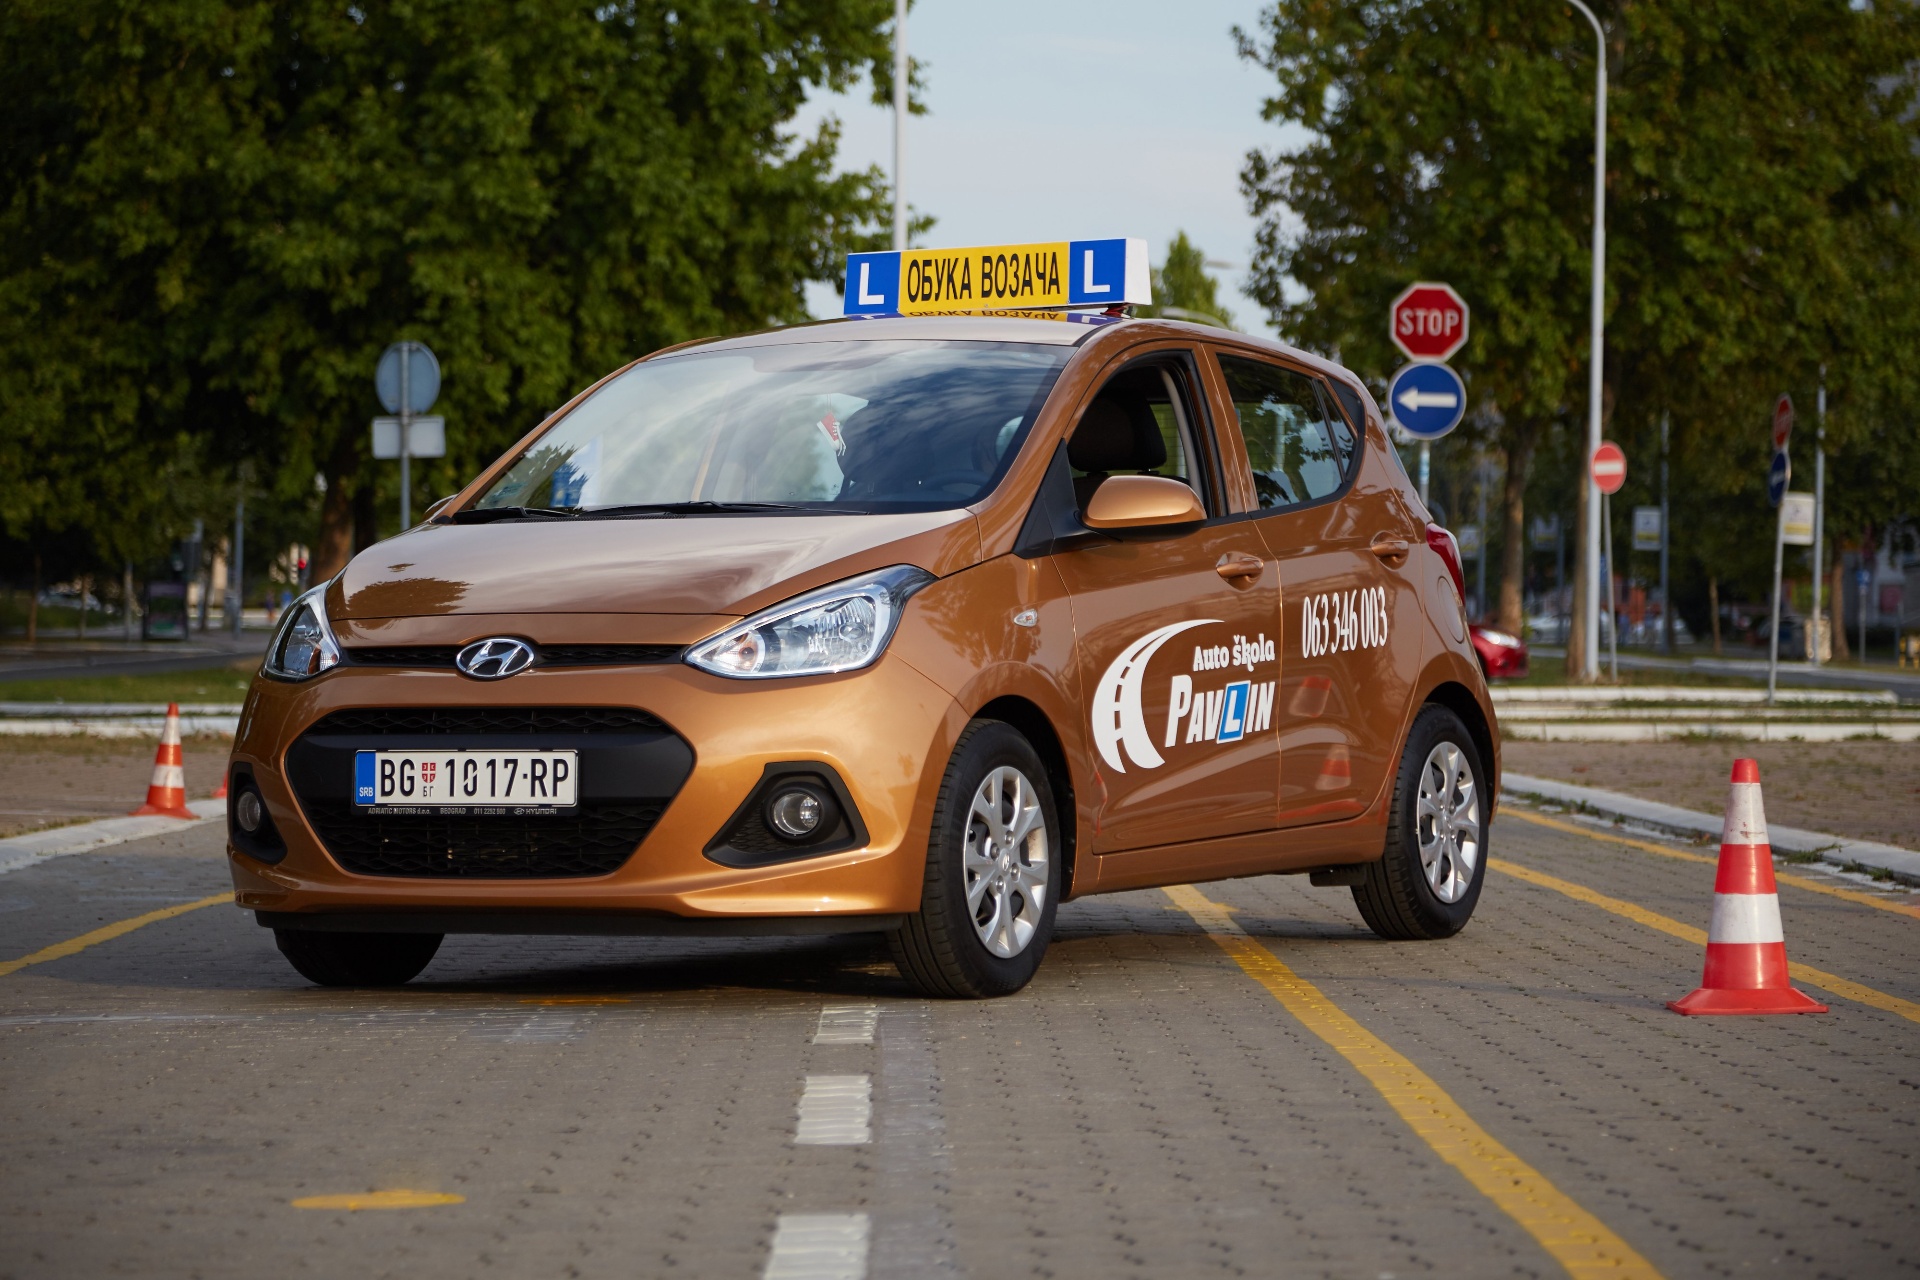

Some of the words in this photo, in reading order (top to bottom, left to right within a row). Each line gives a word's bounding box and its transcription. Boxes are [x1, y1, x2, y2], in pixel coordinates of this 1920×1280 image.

[858, 262, 885, 305] L
[907, 257, 972, 303] ОБУКА
[981, 251, 1061, 299] ВОЗАЧА
[1083, 250, 1111, 294] L
[1399, 307, 1460, 337] STOP
[1302, 594, 1330, 659] 063
[1331, 589, 1359, 654] 346
[1361, 586, 1388, 649] 003
[1193, 645, 1230, 672] Auto
[1232, 632, 1276, 672] škola
[359, 787, 374, 798] SRB
[380, 758, 416, 798] BG
[368, 807, 393, 815] ADRIATIC
[393, 807, 416, 815] MOTORS
[440, 807, 467, 815] BEOGRAD
